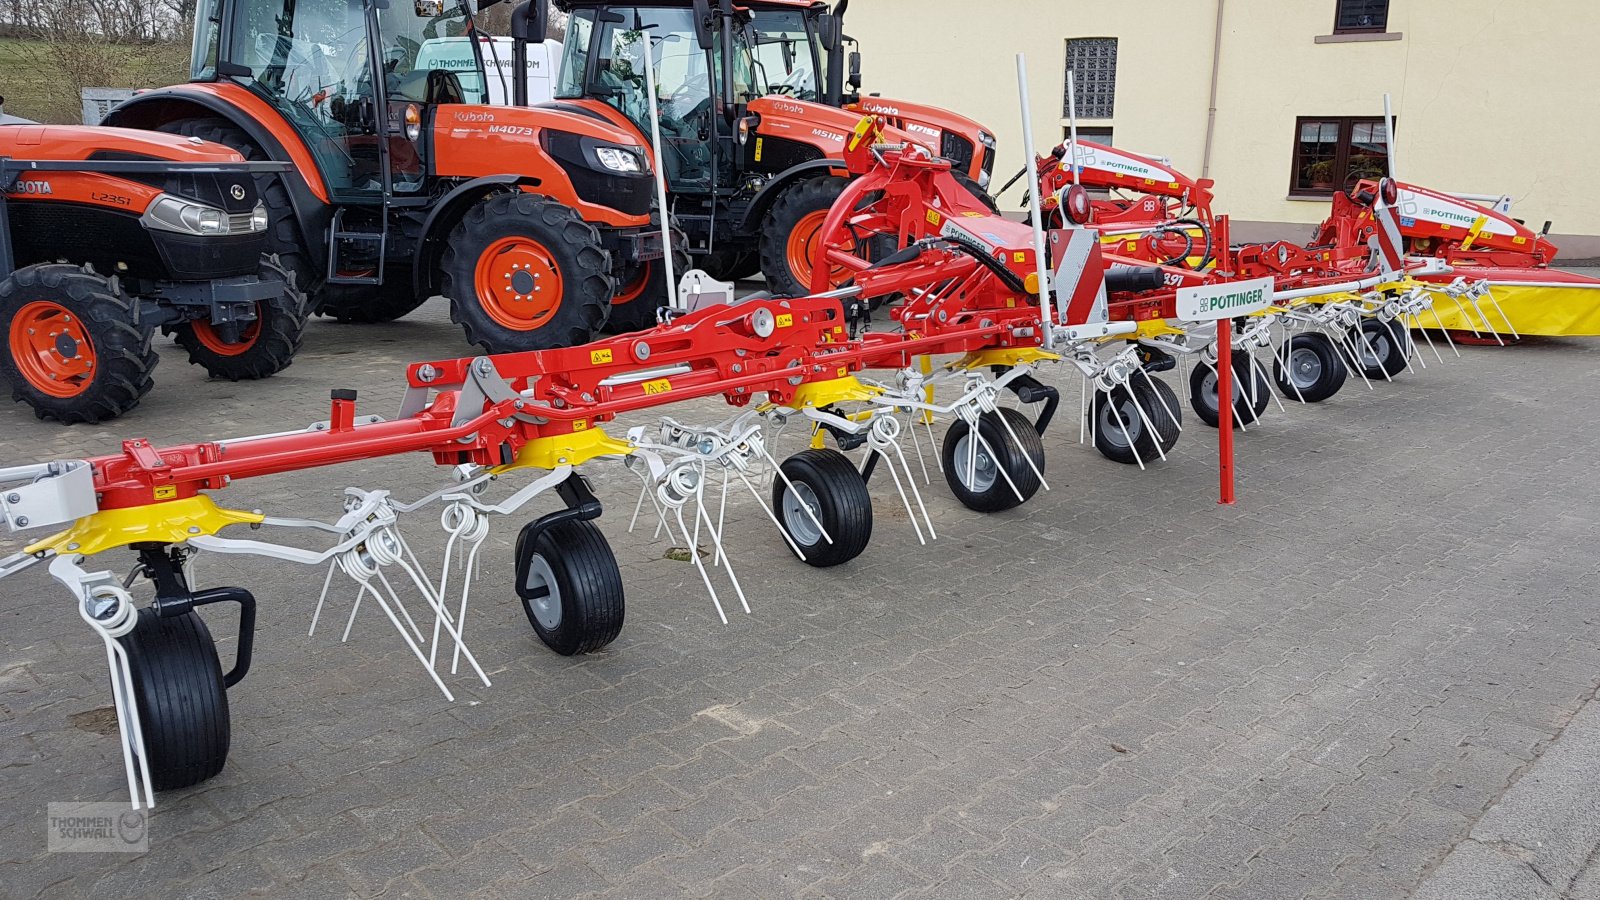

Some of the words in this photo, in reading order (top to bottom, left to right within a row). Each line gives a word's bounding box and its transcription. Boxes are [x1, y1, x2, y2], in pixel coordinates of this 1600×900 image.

[772, 101, 804, 114] Kubota
[862, 102, 898, 115] Kubota
[454, 111, 494, 122] Kubota
[488, 125, 533, 136] M4073
[91, 192, 131, 206] L2351
